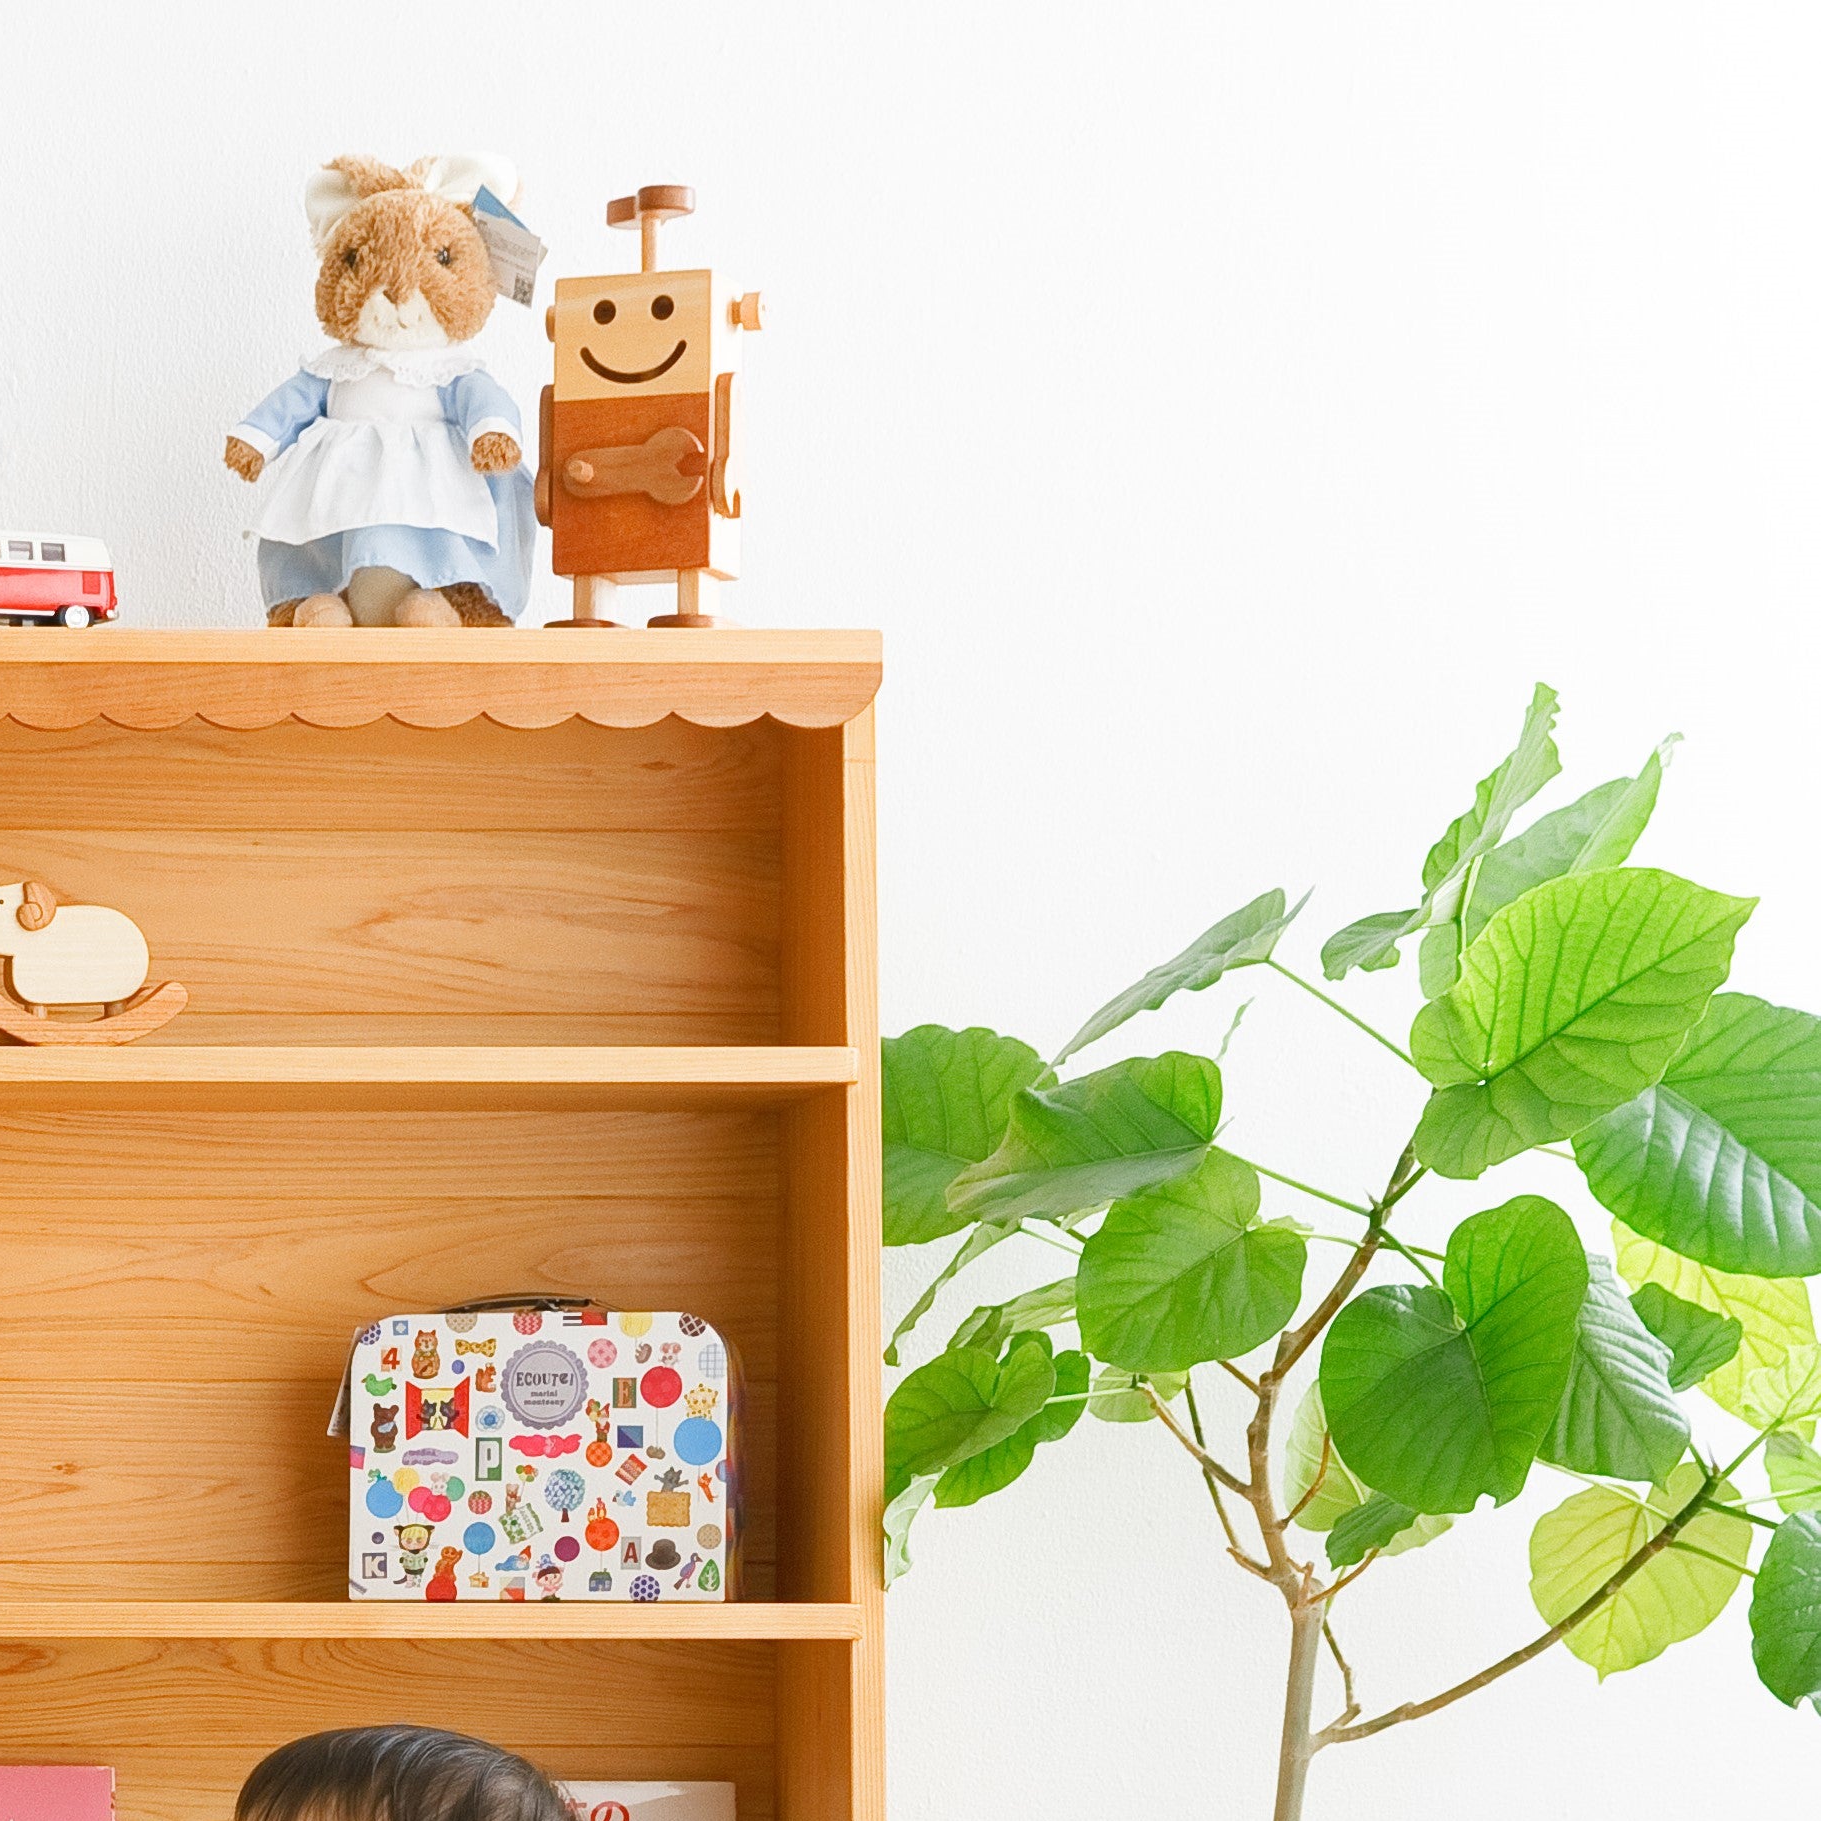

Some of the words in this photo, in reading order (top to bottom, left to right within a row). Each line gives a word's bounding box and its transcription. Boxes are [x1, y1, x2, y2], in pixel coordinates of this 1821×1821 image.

[383, 1347, 400, 1370] 4
[616, 1377, 633, 1408] E
[478, 1440, 500, 1479] P
[623, 1541, 639, 1564] A
[365, 1556, 386, 1578] K
